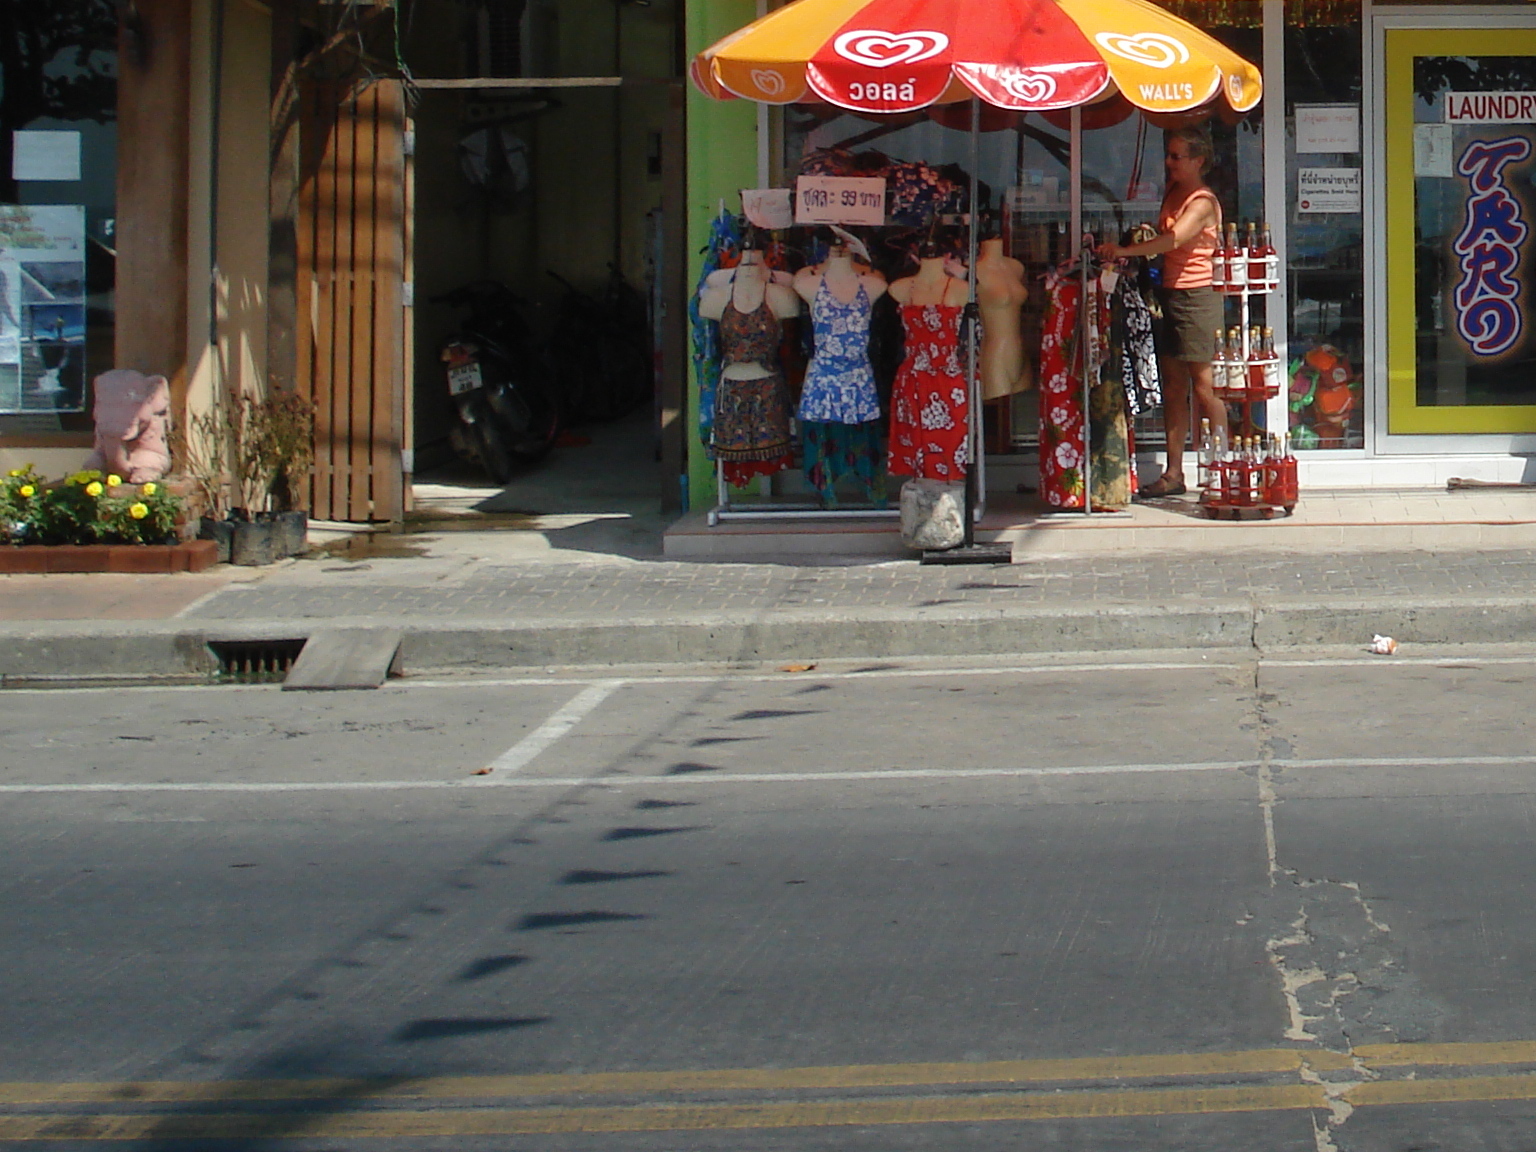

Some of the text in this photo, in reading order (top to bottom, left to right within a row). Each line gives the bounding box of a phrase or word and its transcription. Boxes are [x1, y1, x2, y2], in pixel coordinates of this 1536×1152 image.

[848, 77, 917, 102] วอลล์
[1139, 82, 1193, 101] WALL'S
[841, 189, 857, 206] 99
[859, 192, 881, 208] บาท
[1453, 135, 1532, 357] TARO
